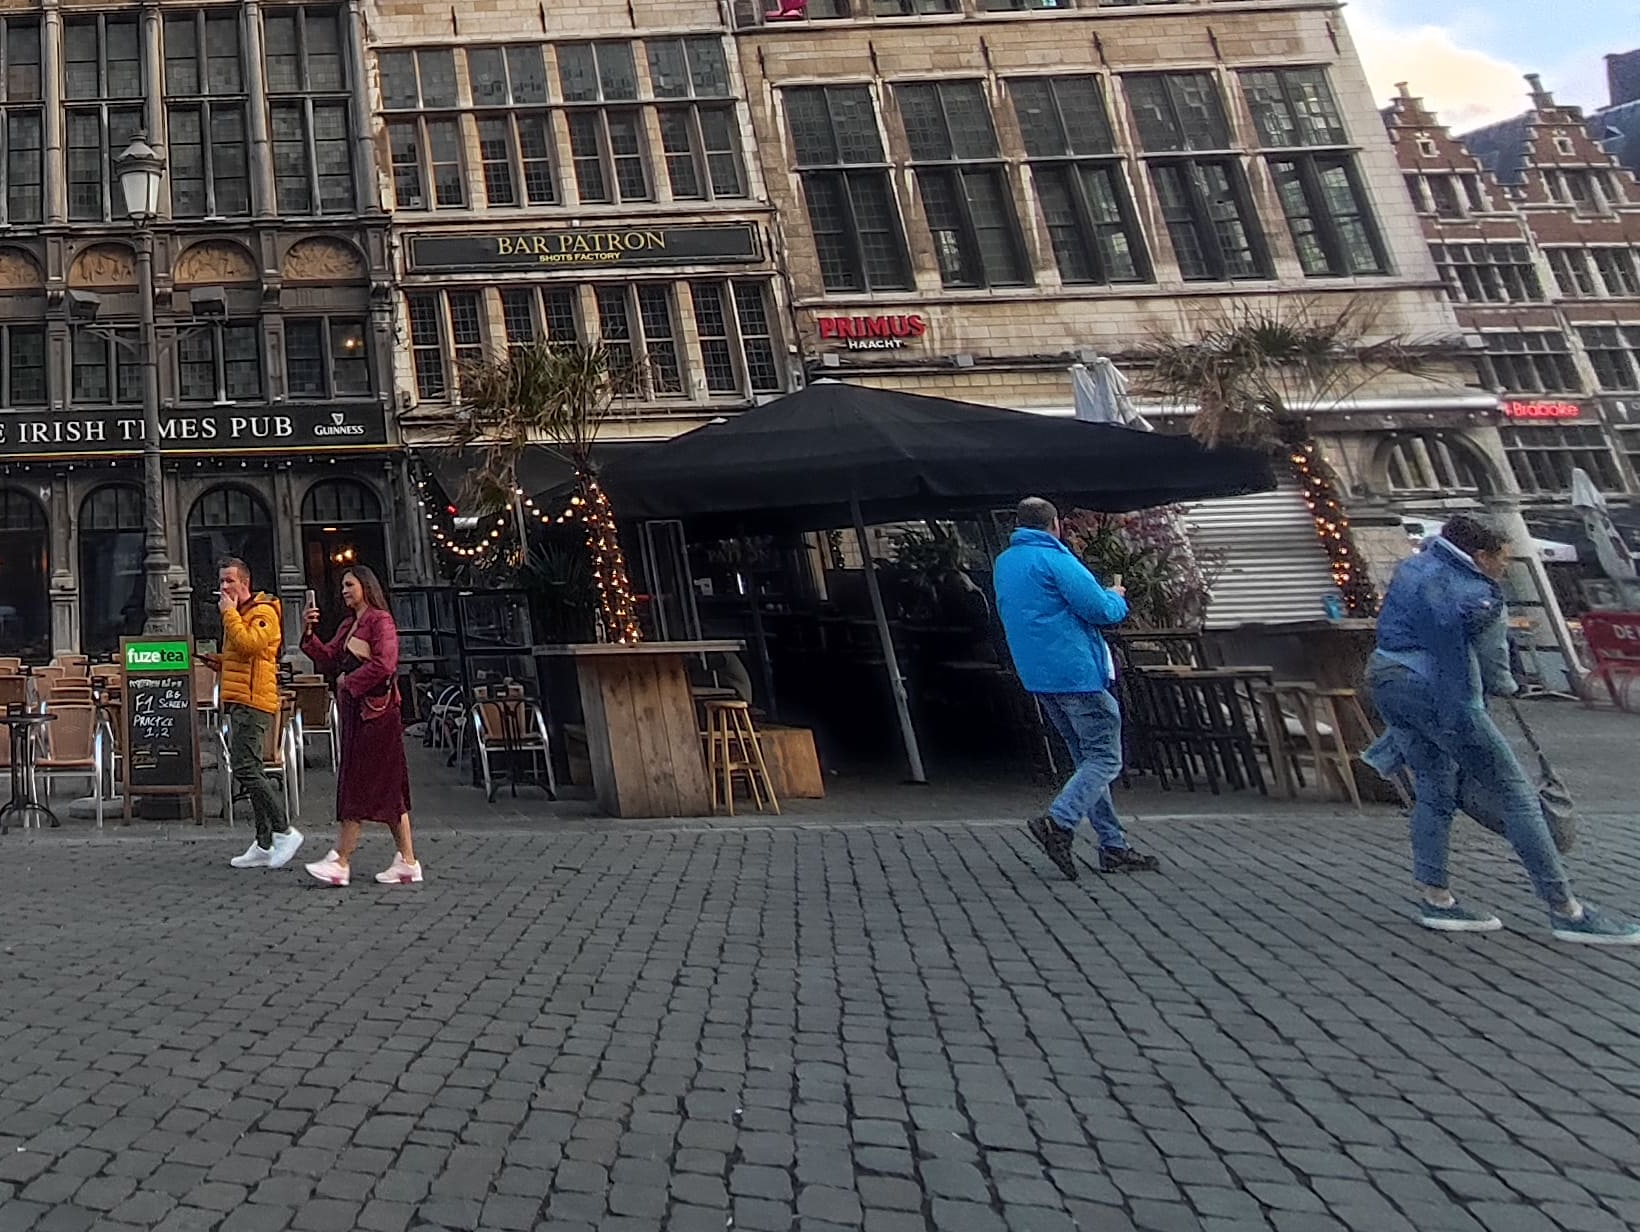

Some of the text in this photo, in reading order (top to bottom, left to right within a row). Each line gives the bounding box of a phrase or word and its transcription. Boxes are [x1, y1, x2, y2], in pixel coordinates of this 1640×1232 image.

[496, 231, 666, 255] BAR PATRON
[539, 252, 622, 262] SHOTS FACTORY
[817, 315, 927, 339] PRIMUS
[848, 339, 903, 350] HAACHT
[18, 420, 106, 443] IRISH
[117, 418, 217, 441] TIMES
[230, 417, 293, 437] PUB
[313, 425, 365, 436] GUINNESS
[127, 648, 184, 663] fuzetea
